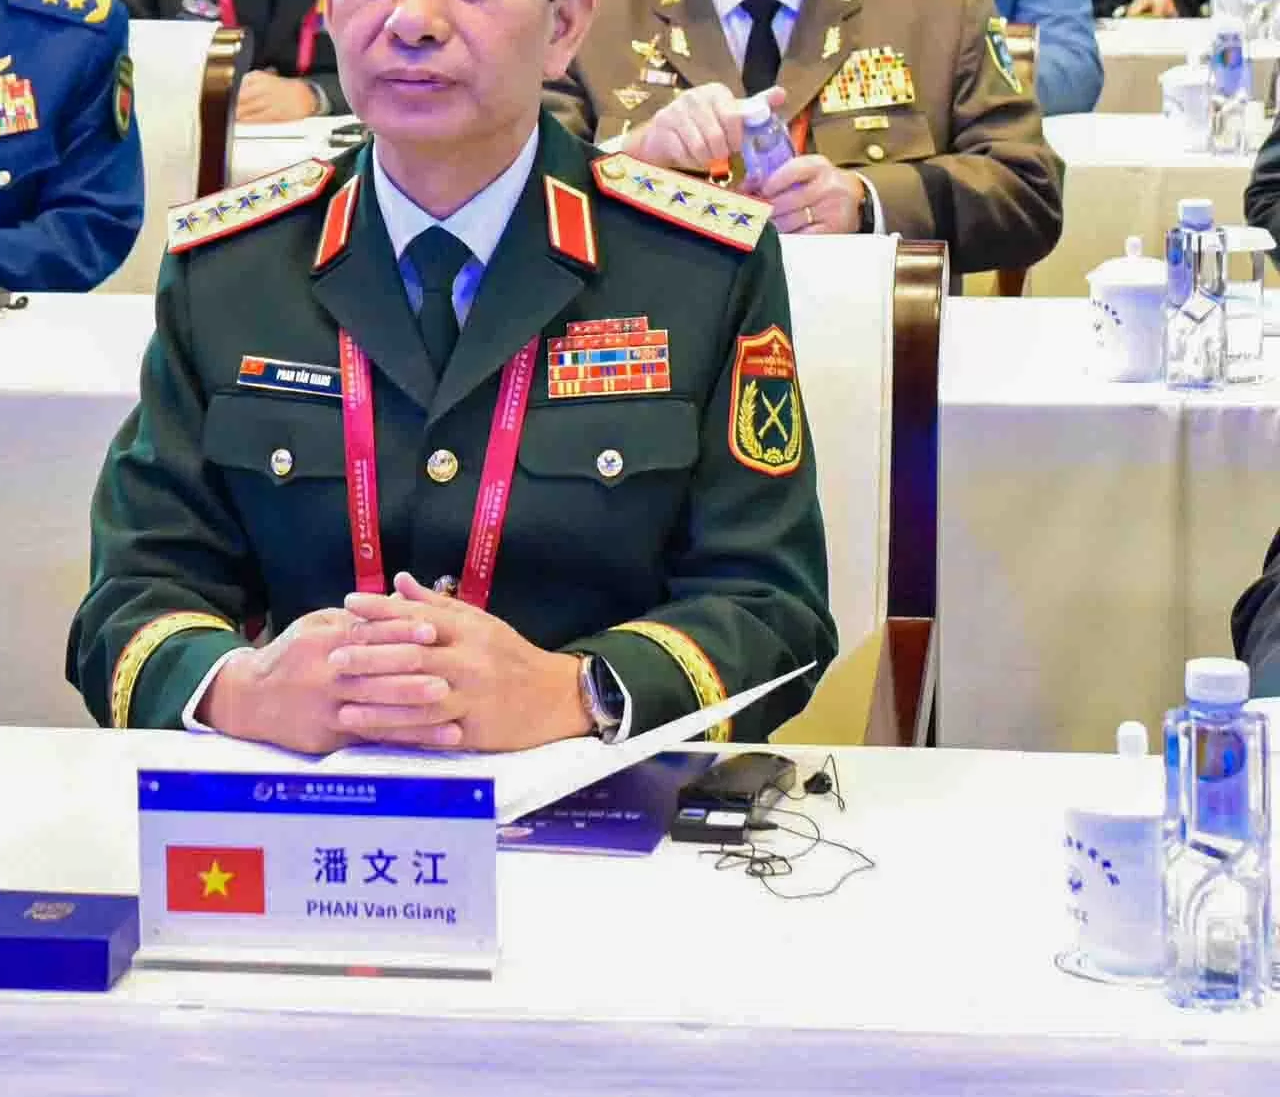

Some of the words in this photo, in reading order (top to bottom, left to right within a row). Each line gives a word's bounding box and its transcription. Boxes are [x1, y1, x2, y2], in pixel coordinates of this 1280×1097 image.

[313, 846, 449, 885] 潘文江
[306, 900, 359, 919] PHAN
[363, 901, 398, 920] Van
[402, 901, 457, 924] Giang
